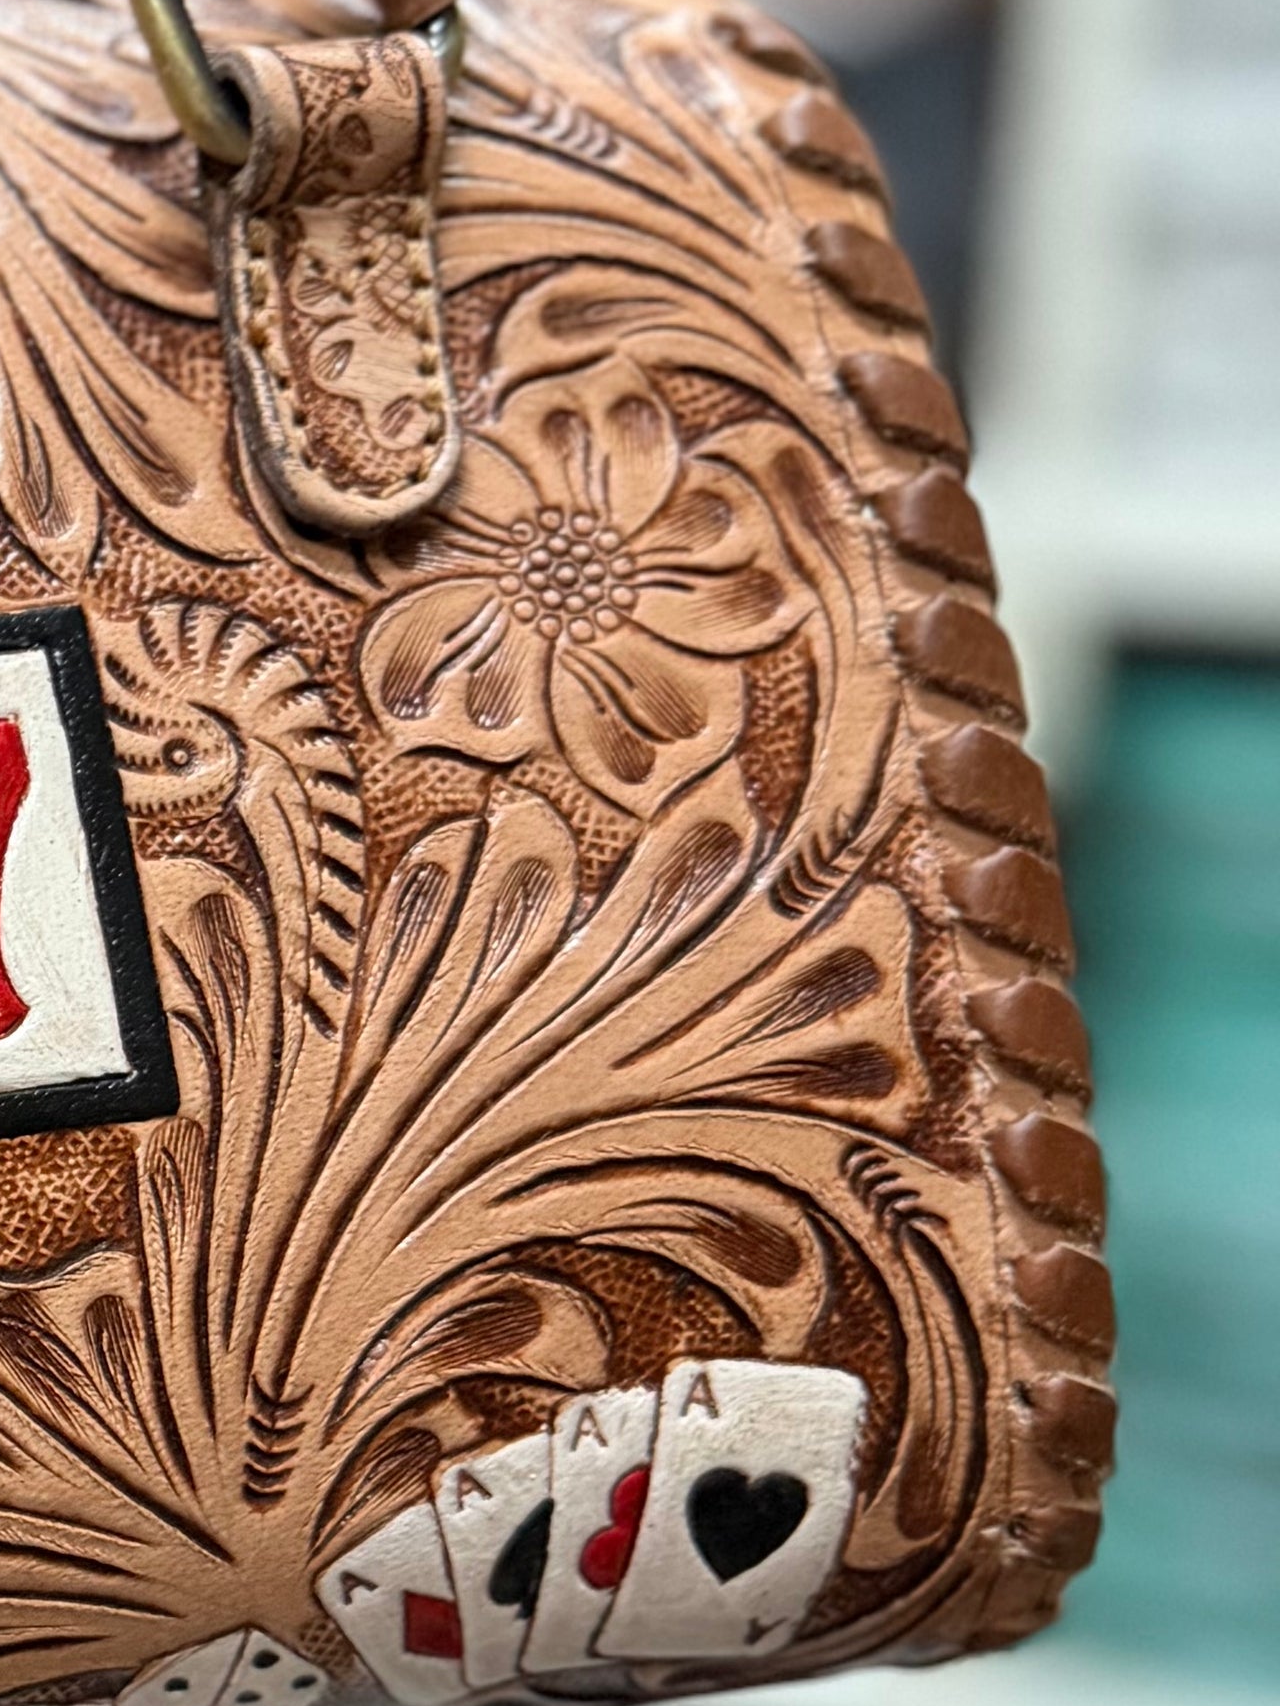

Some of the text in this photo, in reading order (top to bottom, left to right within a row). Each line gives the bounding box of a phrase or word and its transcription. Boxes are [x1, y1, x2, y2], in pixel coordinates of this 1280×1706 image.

[679, 1372, 719, 1419] A
[570, 1406, 609, 1452] A
[456, 1468, 493, 1512] A
[340, 1570, 379, 1606] A
